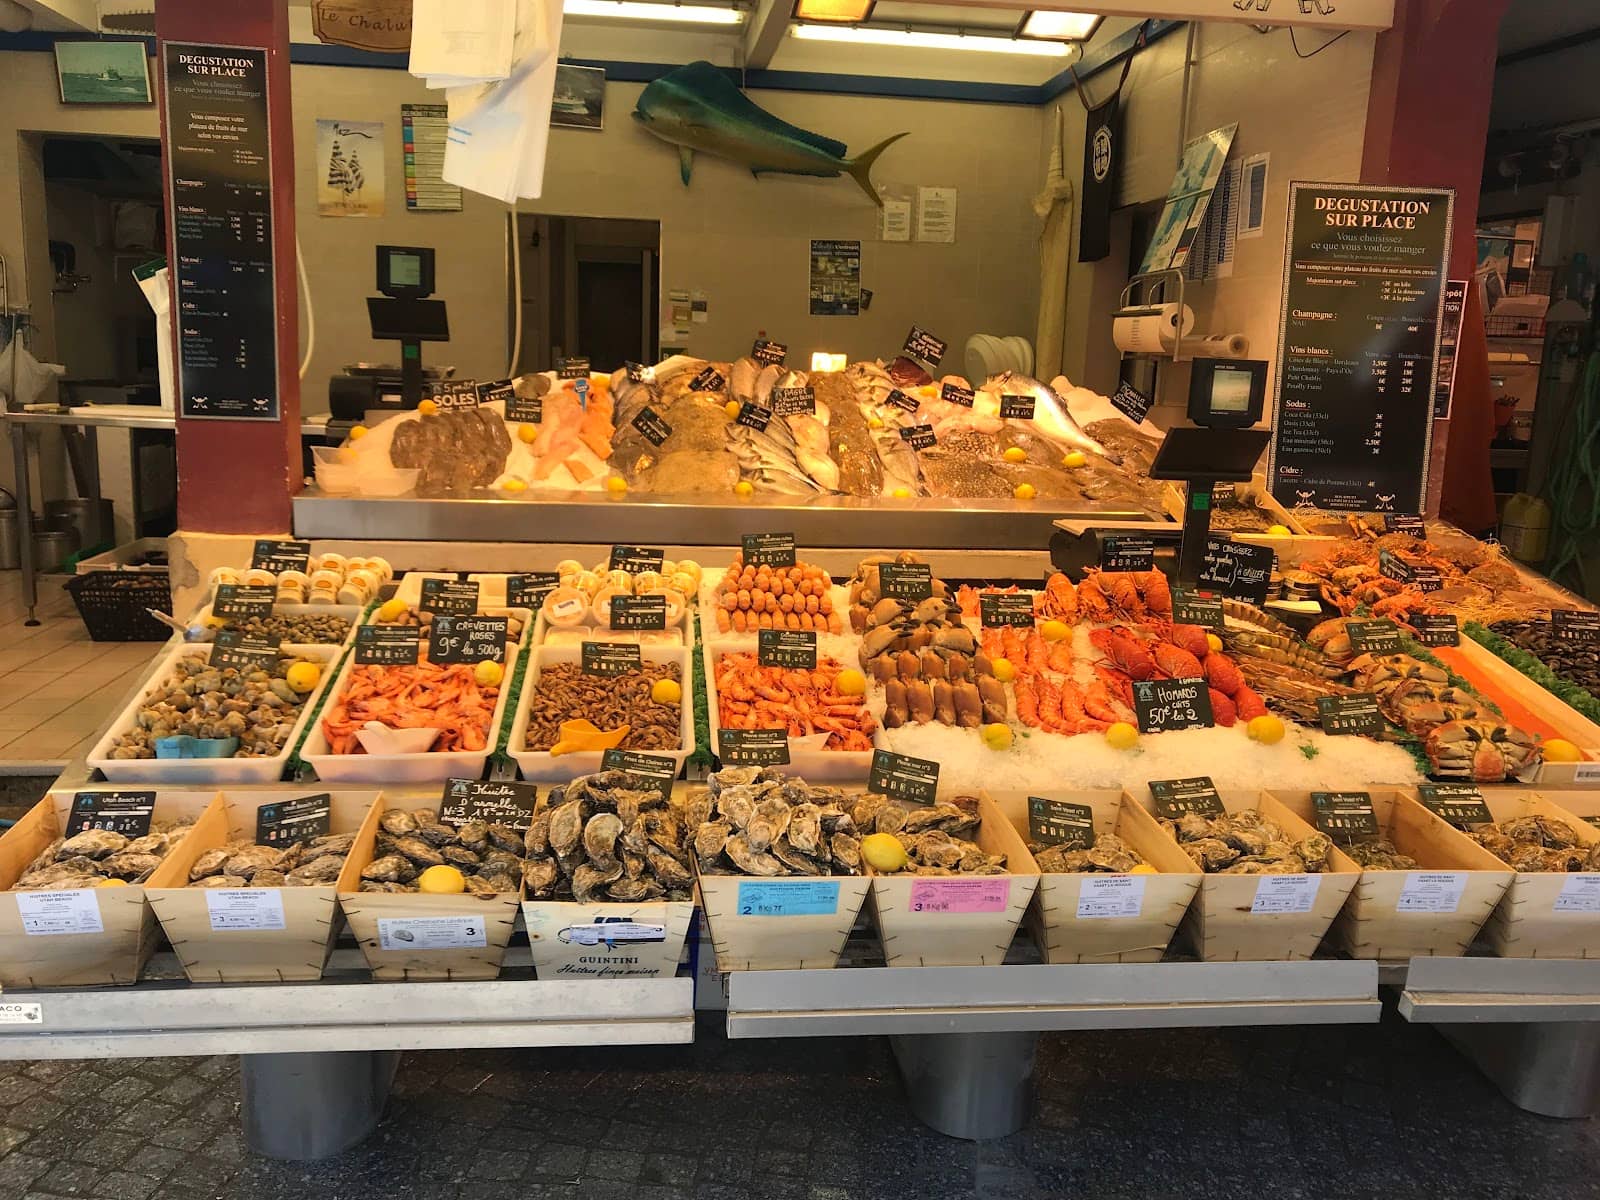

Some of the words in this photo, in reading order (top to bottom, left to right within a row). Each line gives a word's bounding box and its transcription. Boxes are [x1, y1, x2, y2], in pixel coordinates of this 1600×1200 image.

[322, 8, 340, 22] Le
[179, 55, 254, 68] DEGUSTATION
[188, 66, 209, 75] SUR
[212, 67, 247, 77] PLACE
[1314, 197, 1431, 215] DEGUSTATION
[1326, 213, 1358, 228] SUR
[1362, 215, 1416, 230] PLACE
[1337, 232, 1358, 242] Vous
[1360, 232, 1403, 244] choisissez
[1323, 243, 1339, 252] que
[1364, 244, 1392, 252] voulez
[1394, 246, 1426, 256] manger
[1293, 310, 1333, 319] Champagne
[1290, 346, 1306, 354] Vins
[1307, 347, 1329, 355] blancs
[433, 393, 475, 407] SOLES
[1286, 400, 1307, 408] Sodas
[1280, 466, 1300, 474] Cidre
[456, 622, 506, 631] CREVETTES
[470, 632, 495, 641] ROSES
[437, 637, 461, 656] 9€
[477, 644, 503, 661] 500g
[1150, 706, 1171, 725] 50€
[1171, 710, 1185, 721] les
[1186, 709, 1199, 720] 2
[743, 906, 753, 915] 2
[915, 903, 923, 912] 3
[466, 928, 476, 936] 3
